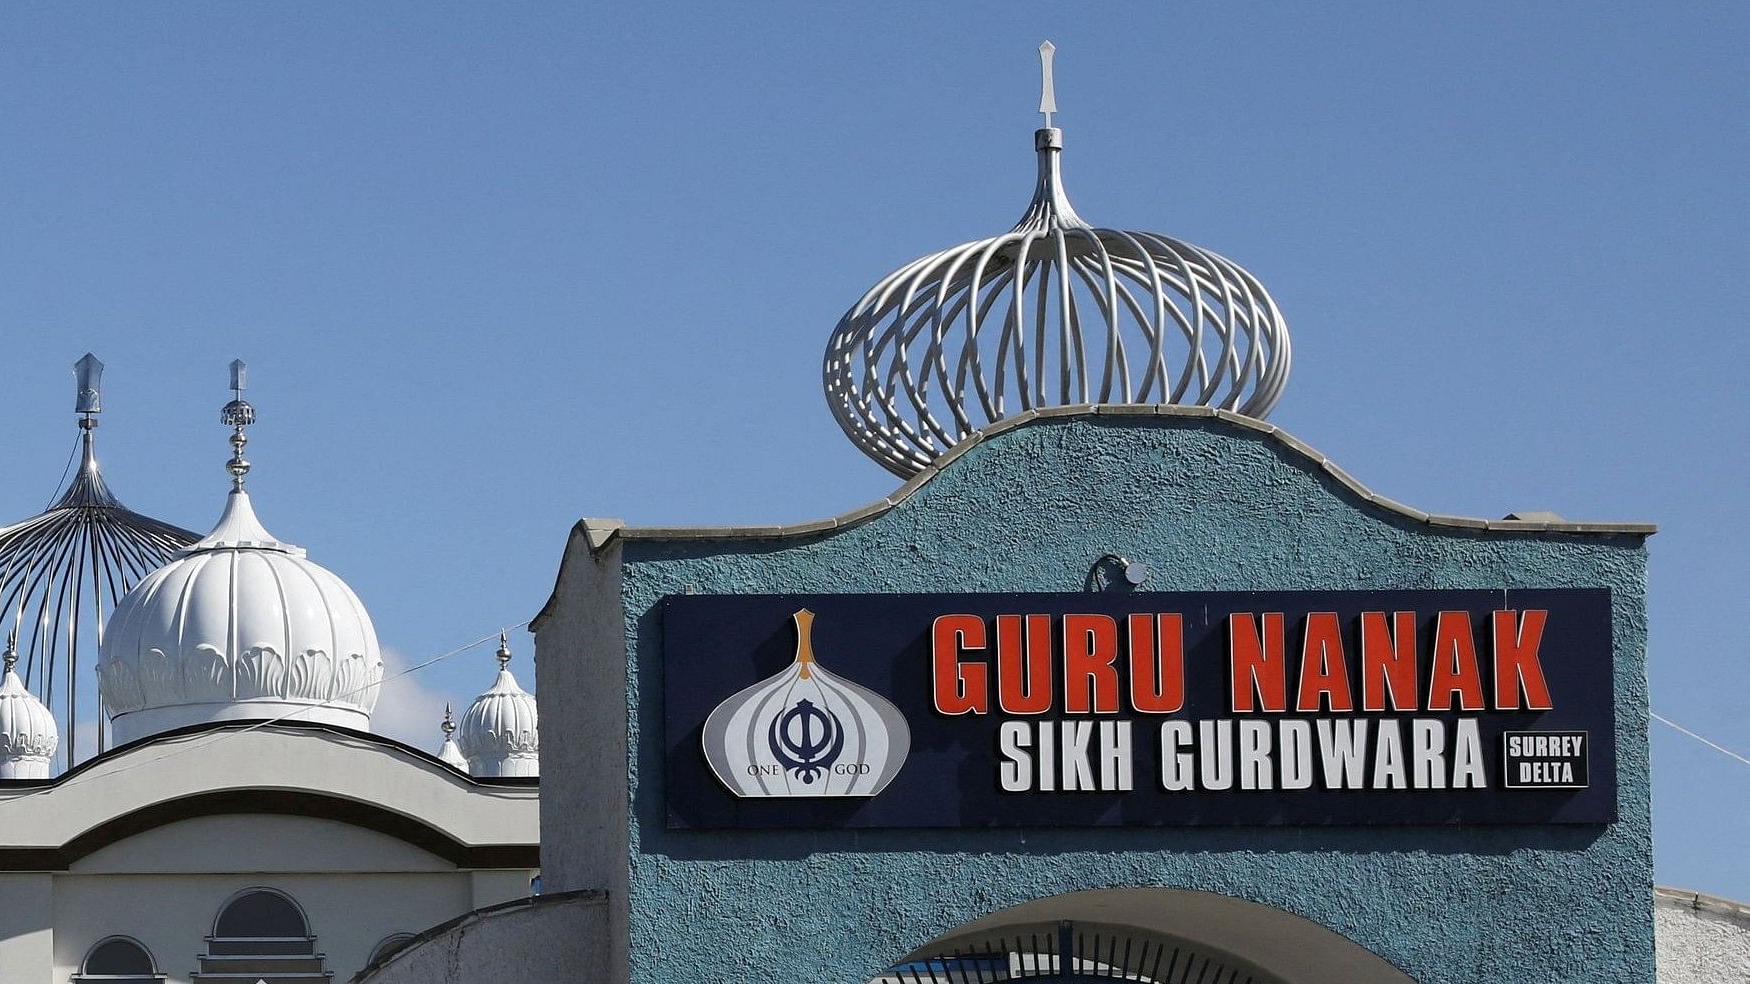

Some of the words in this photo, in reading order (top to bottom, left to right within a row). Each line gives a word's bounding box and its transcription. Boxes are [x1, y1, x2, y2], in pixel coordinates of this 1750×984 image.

[931, 612, 1184, 715] GURU
[1229, 609, 1553, 714] NANAK
[999, 717, 1134, 793] SIKH
[1161, 717, 1488, 792] GURDWARA
[1509, 736, 1583, 757] SURREY
[747, 764, 779, 776] ONE
[834, 763, 870, 775] GOD
[1519, 762, 1574, 783] DELTA
